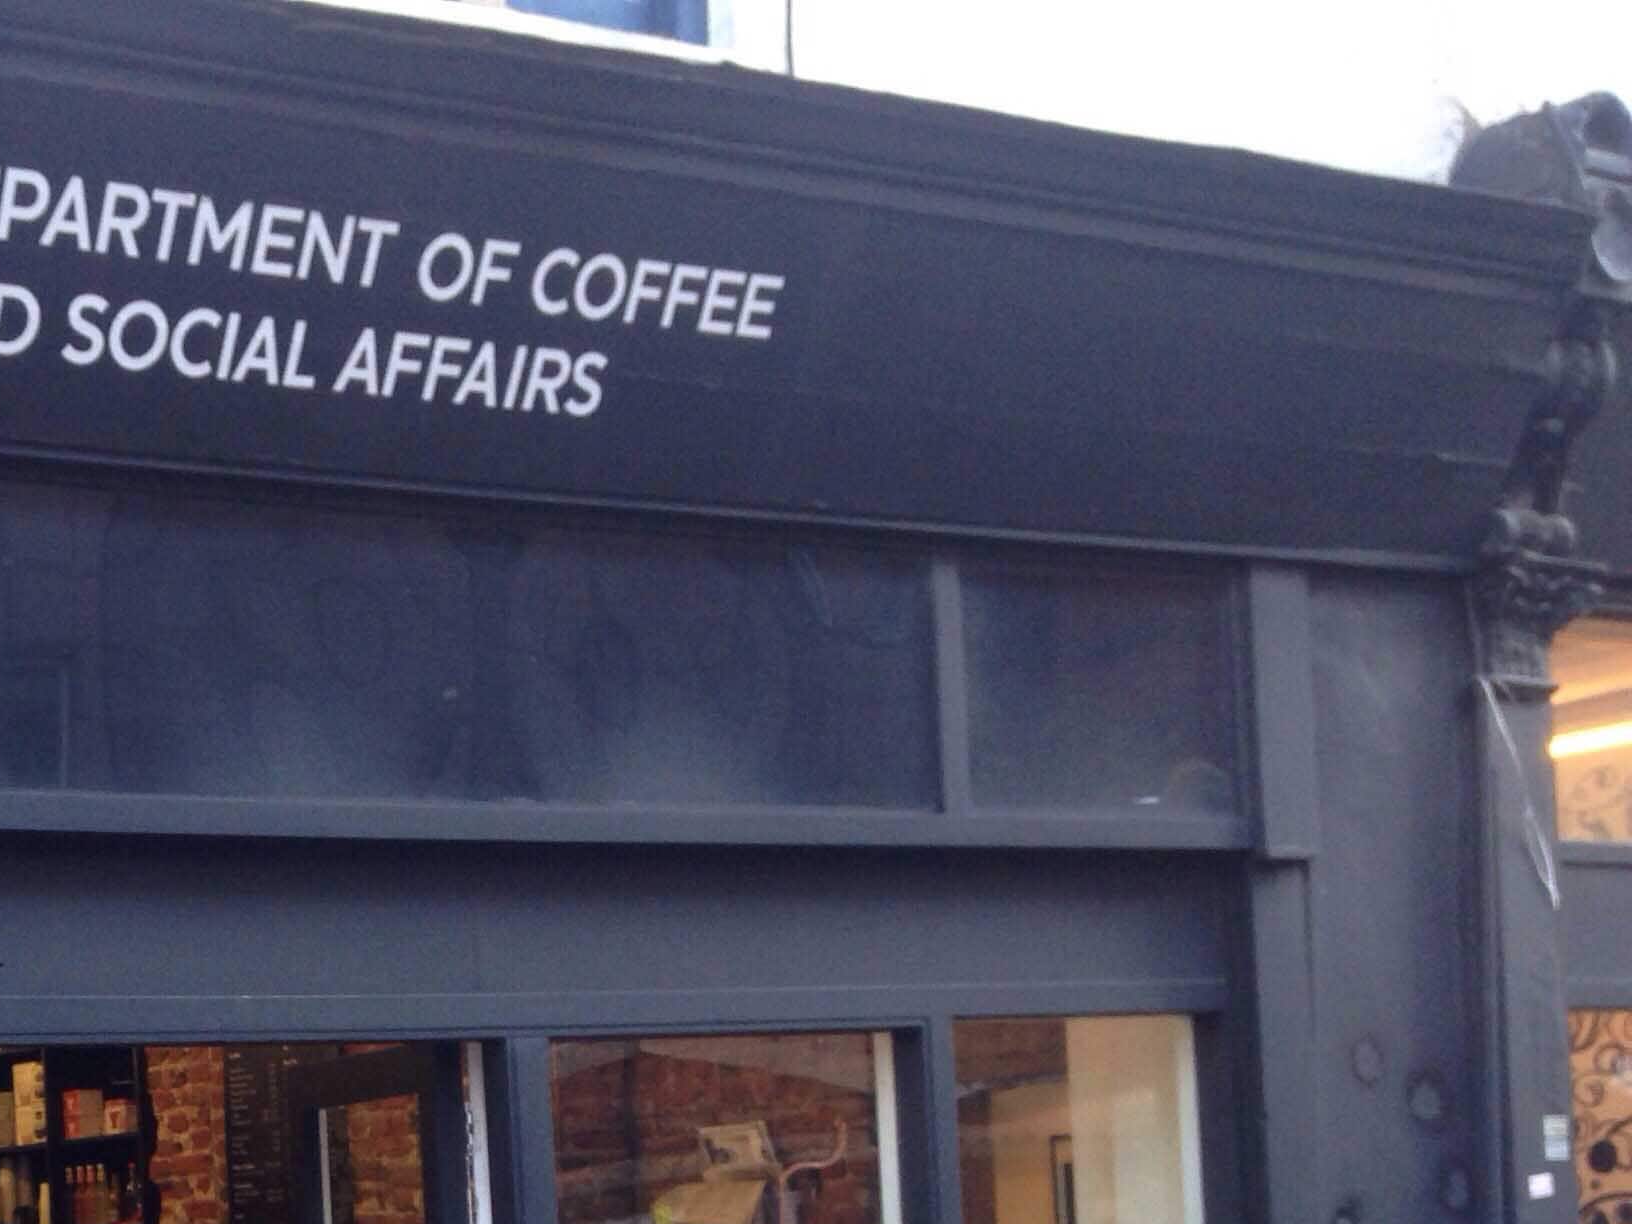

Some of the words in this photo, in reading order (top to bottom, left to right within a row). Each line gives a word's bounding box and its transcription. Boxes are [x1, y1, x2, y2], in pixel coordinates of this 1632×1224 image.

[418, 232, 521, 305] OF
[532, 248, 785, 339] COFFEE
[61, 293, 315, 388] SOCIAL
[333, 327, 608, 416] AFFAIRS
